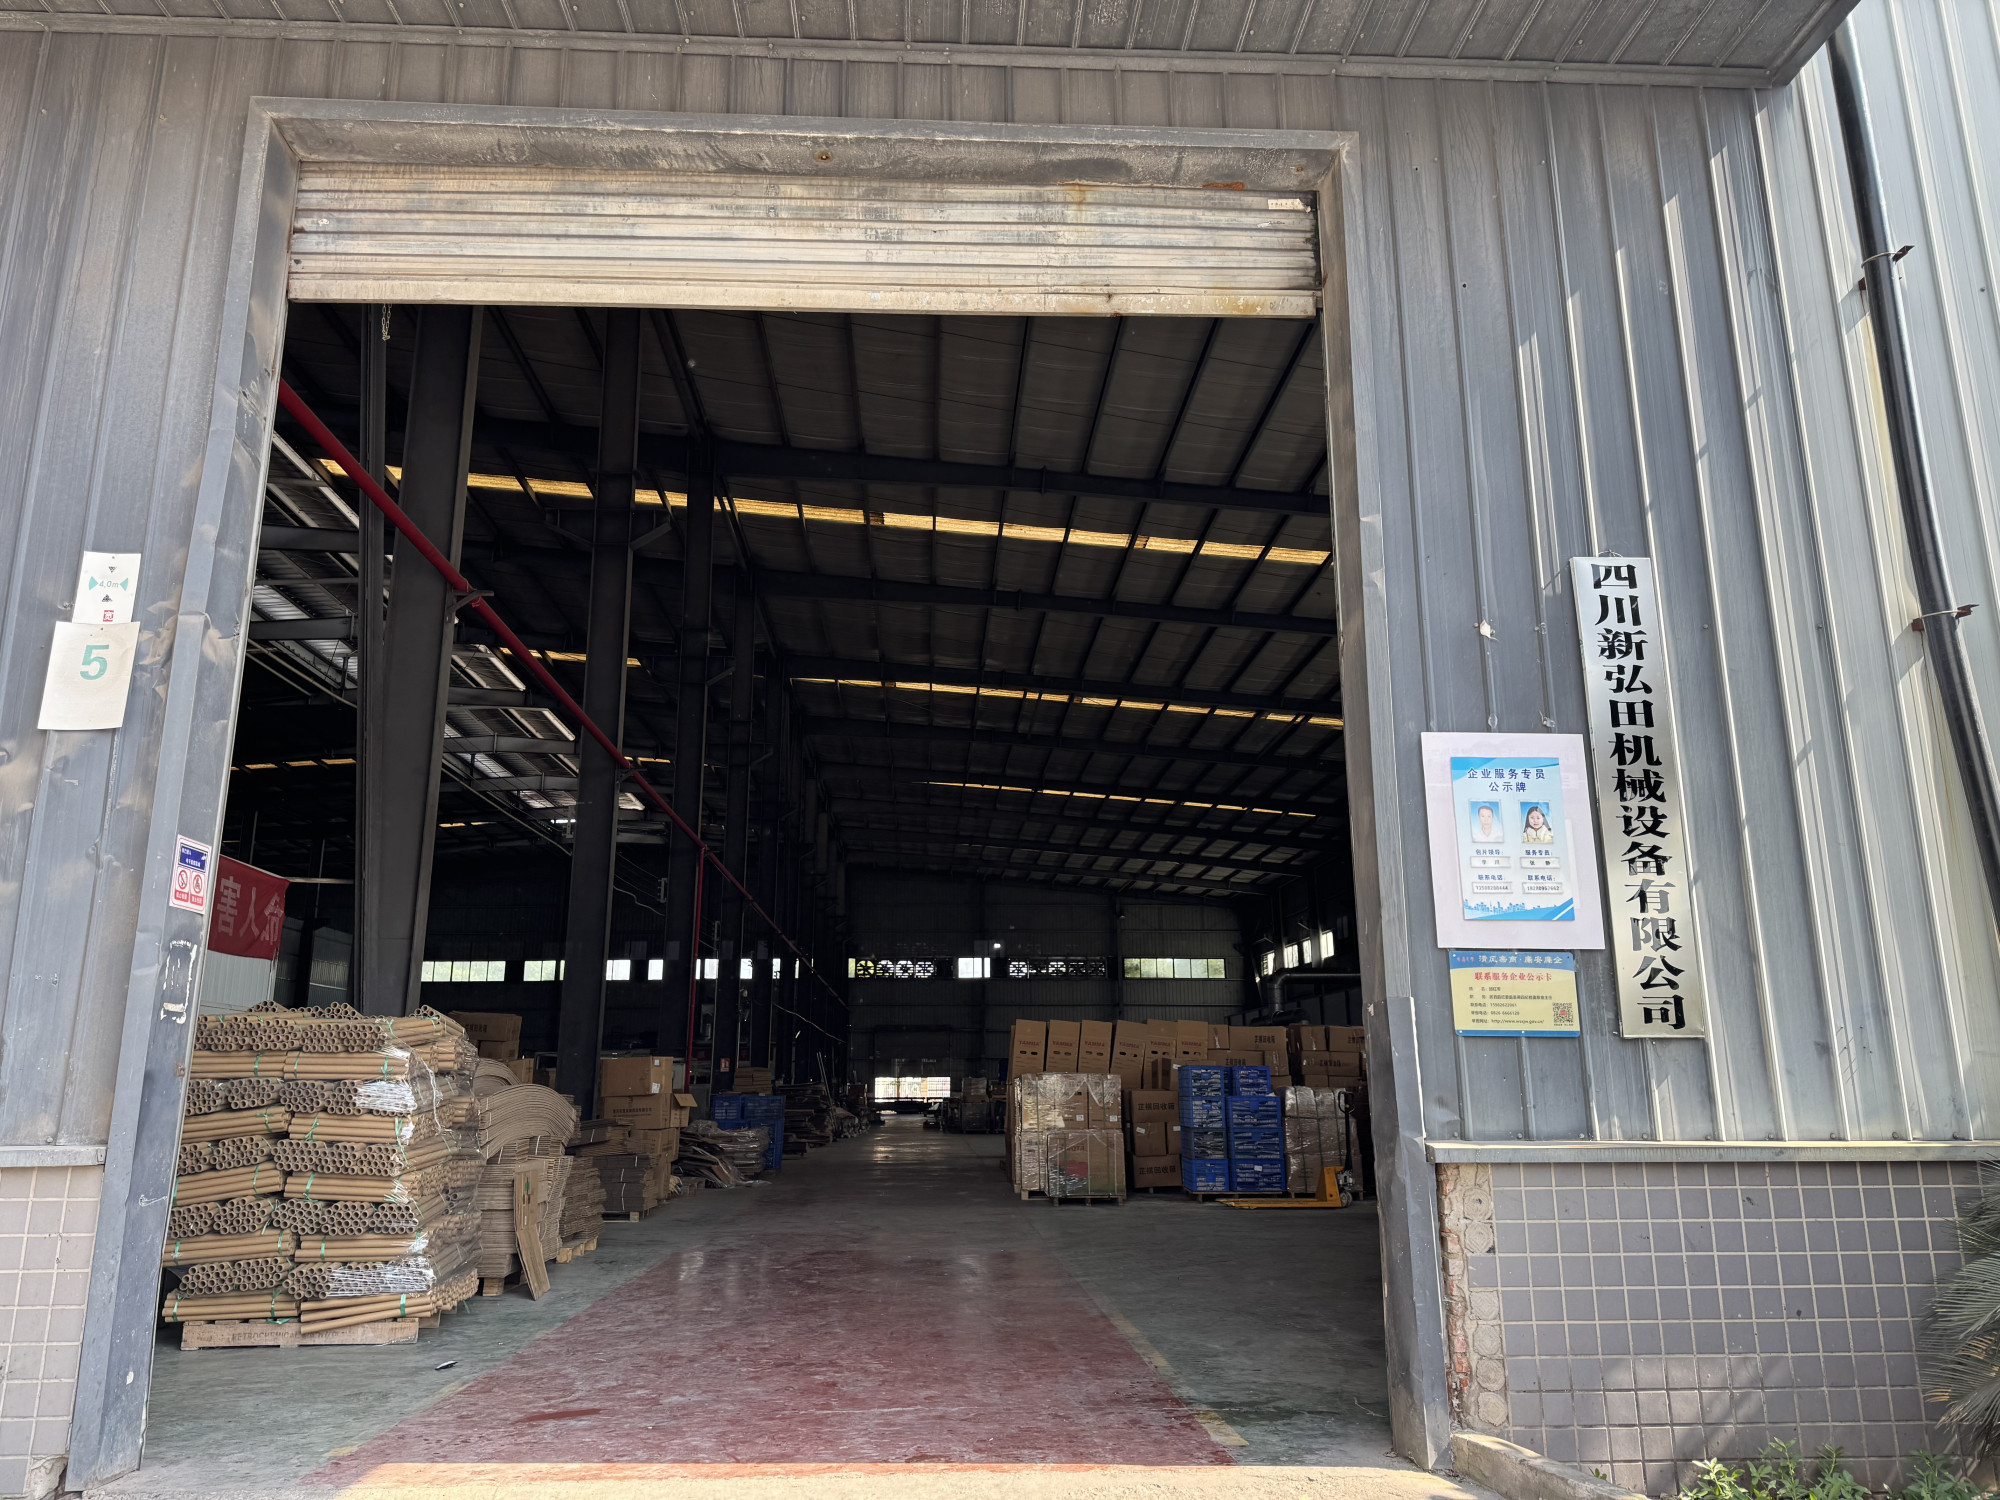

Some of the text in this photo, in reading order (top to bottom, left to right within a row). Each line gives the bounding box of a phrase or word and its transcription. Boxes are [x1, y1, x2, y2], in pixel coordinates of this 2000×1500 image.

[80, 644, 110, 681] 5
[1467, 768, 1546, 780] 企业服务专员
[1488, 781, 1527, 793] 公示牌
[1591, 563, 1686, 1030] 四川新弘田机械设备有限公司
[1474, 972, 1552, 981] 联系服务企业公示卡
